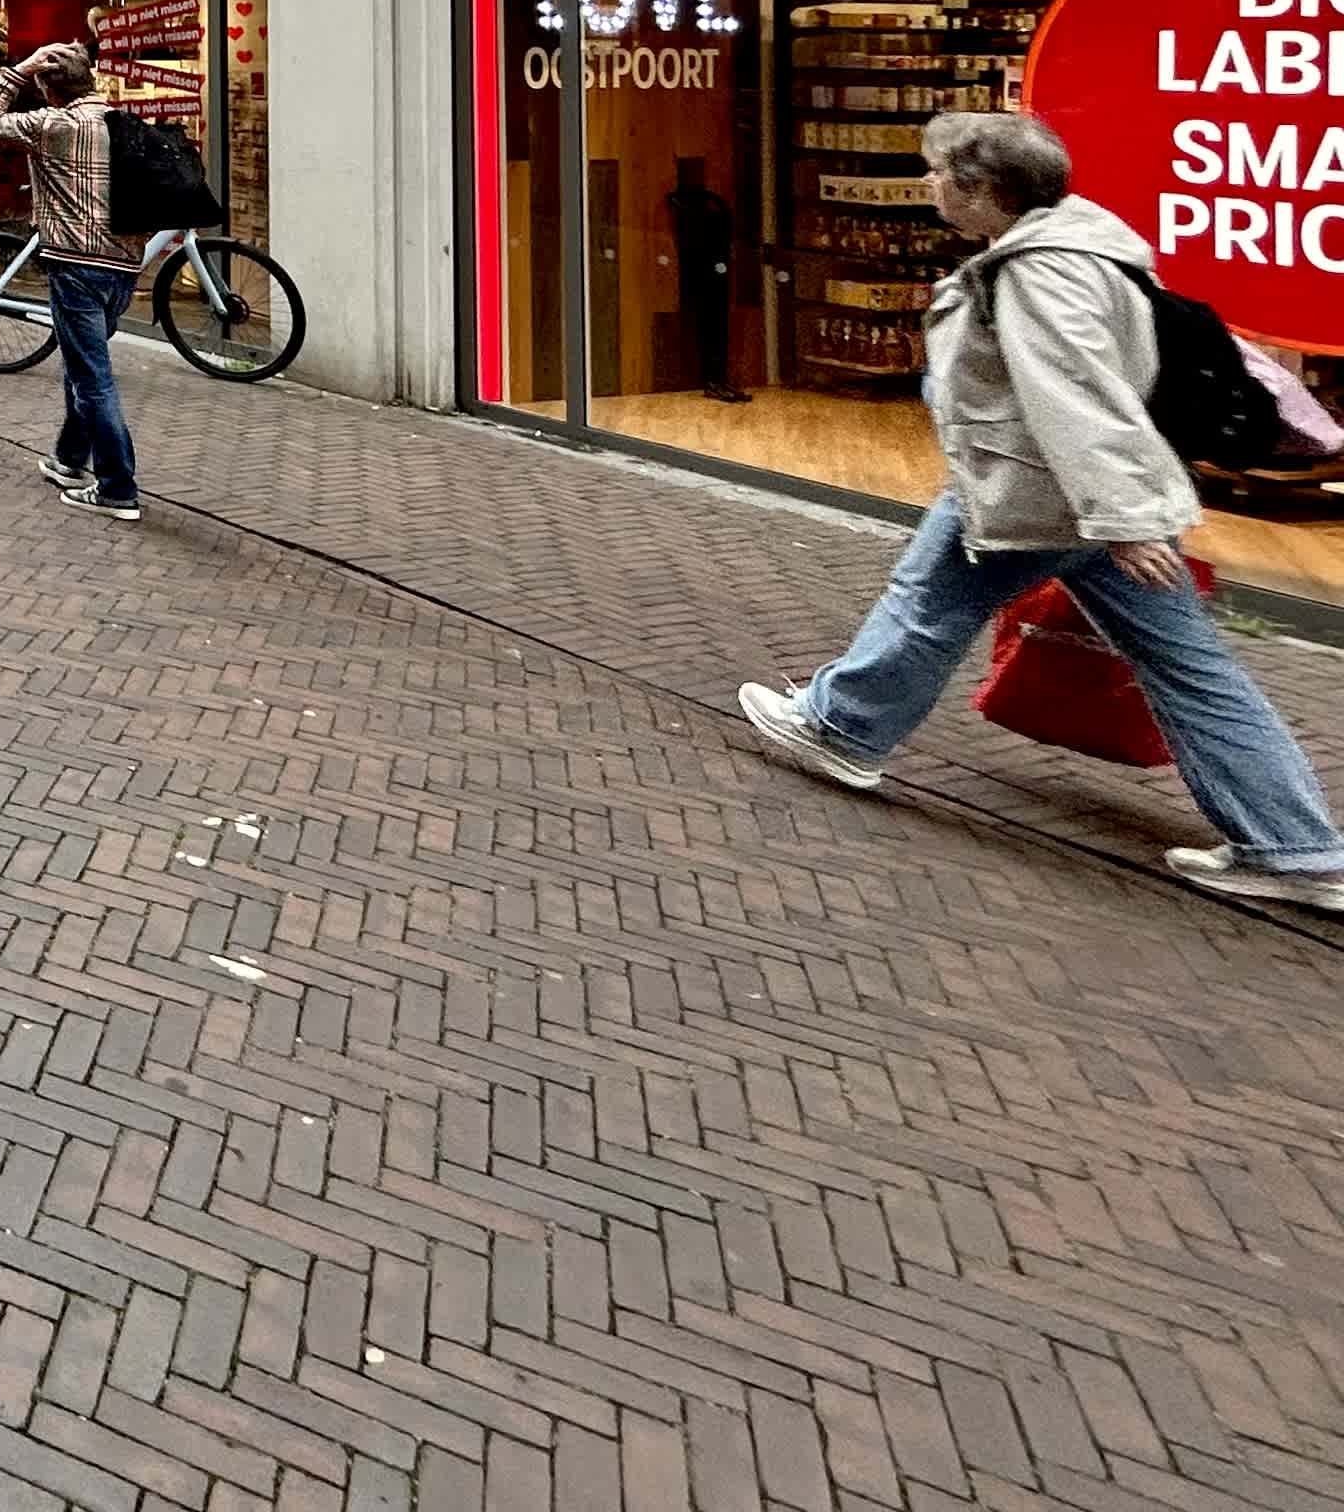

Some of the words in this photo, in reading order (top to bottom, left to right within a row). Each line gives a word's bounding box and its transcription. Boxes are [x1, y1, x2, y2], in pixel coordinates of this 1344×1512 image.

[128, 13, 138, 26] je
[140, 6, 159, 21] niet
[160, 0, 196, 15] missen
[99, 38, 112, 49] dit
[114, 35, 128, 48] wil
[131, 36, 141, 49] je
[143, 32, 163, 43] niet
[165, 29, 199, 41] missen
[99, 60, 112, 70] dit
[114, 62, 128, 73] wil
[131, 64, 141, 78] je
[142, 68, 161, 80] niet
[163, 74, 199, 89] missen
[142, 103, 162, 113] niet
[163, 102, 200, 112] missen
